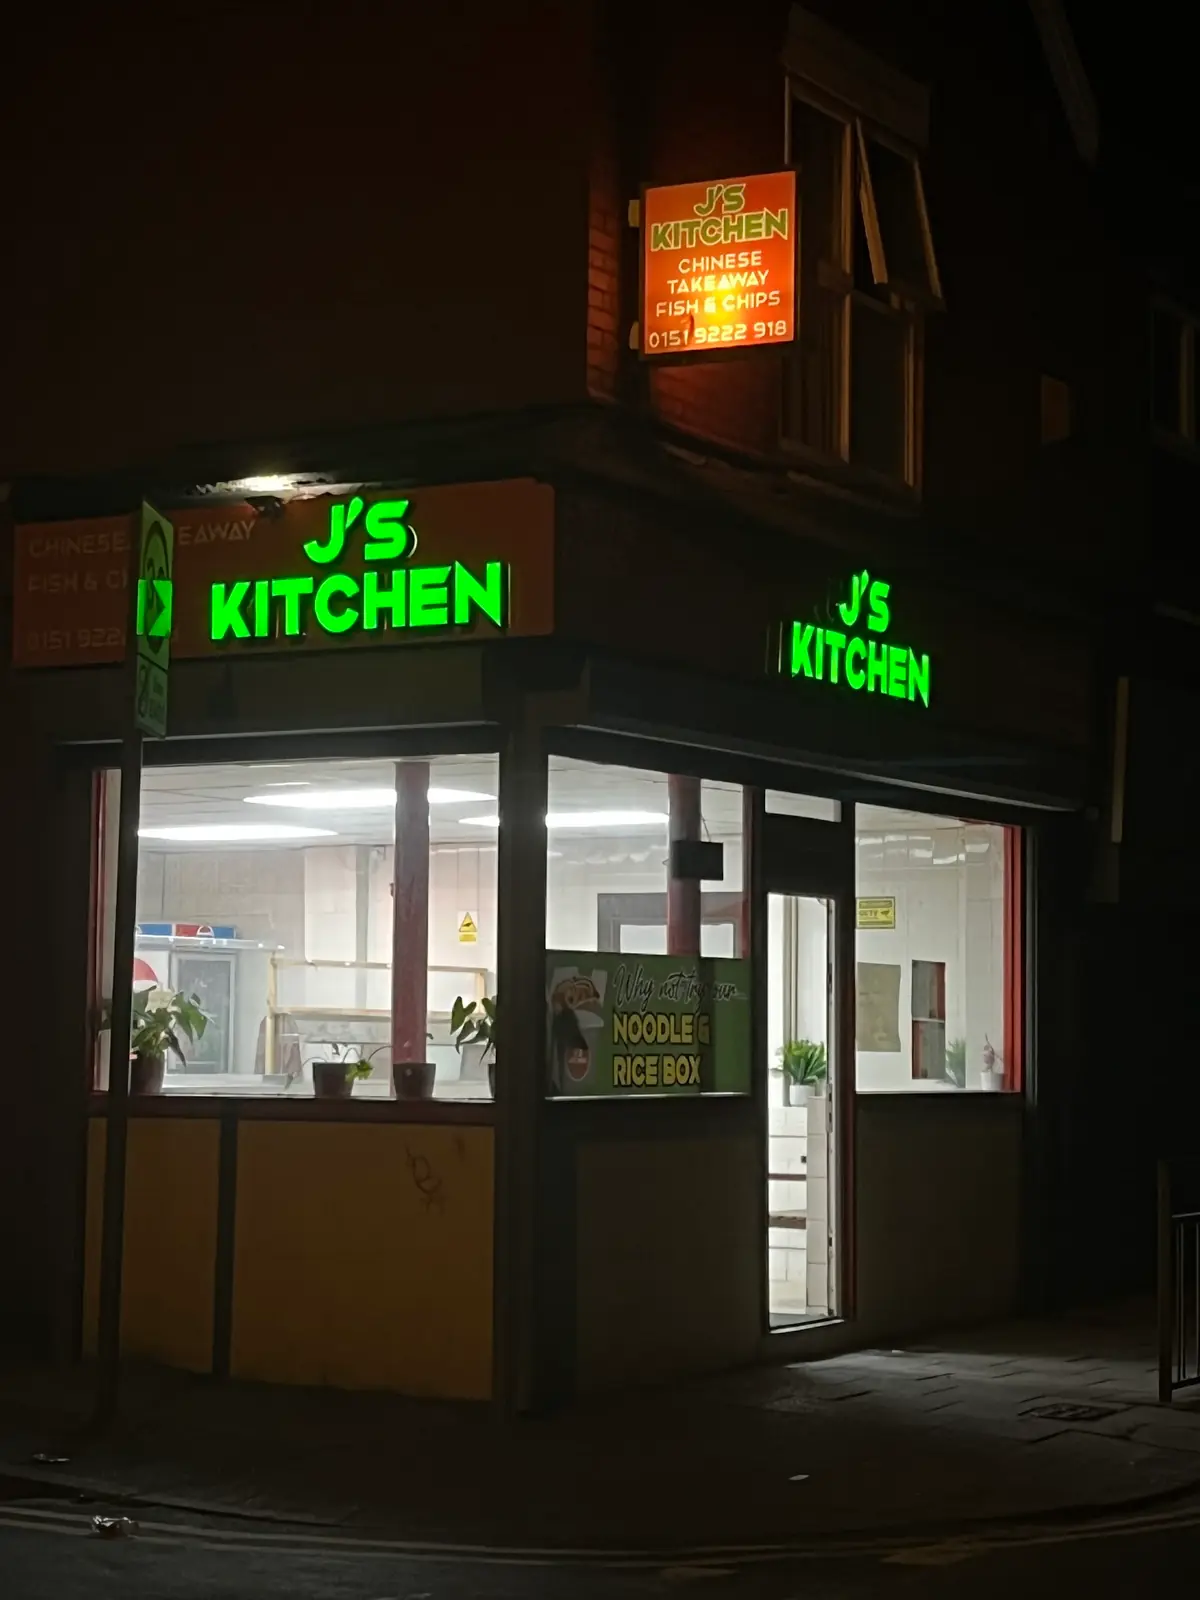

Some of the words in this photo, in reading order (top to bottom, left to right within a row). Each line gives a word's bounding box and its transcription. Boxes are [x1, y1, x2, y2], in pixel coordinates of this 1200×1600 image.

[693, 182, 747, 217] J'S
[650, 207, 789, 252] KITCHEN
[667, 269, 769, 294] TAKEAWAY
[678, 250, 762, 274] CHINESE
[656, 297, 699, 318] FISH
[721, 290, 781, 312] CHIPS
[649, 330, 689, 348] 0151
[693, 323, 748, 345] 9222
[753, 320, 788, 339] 918
[28, 529, 129, 559] CHINESE
[178, 519, 257, 546] EAWAY
[303, 496, 410, 564] J'S
[28, 570, 78, 595] FISH
[211, 560, 502, 640] KITCHEN
[838, 569, 891, 633] J'S
[791, 621, 930, 708] KITCHEN
[612, 963, 655, 1013] Why
[658, 969, 686, 1001] not
[612, 1008, 695, 1050] NOODLE
[612, 1053, 660, 1088] RICE
[662, 1053, 702, 1088] BOX
